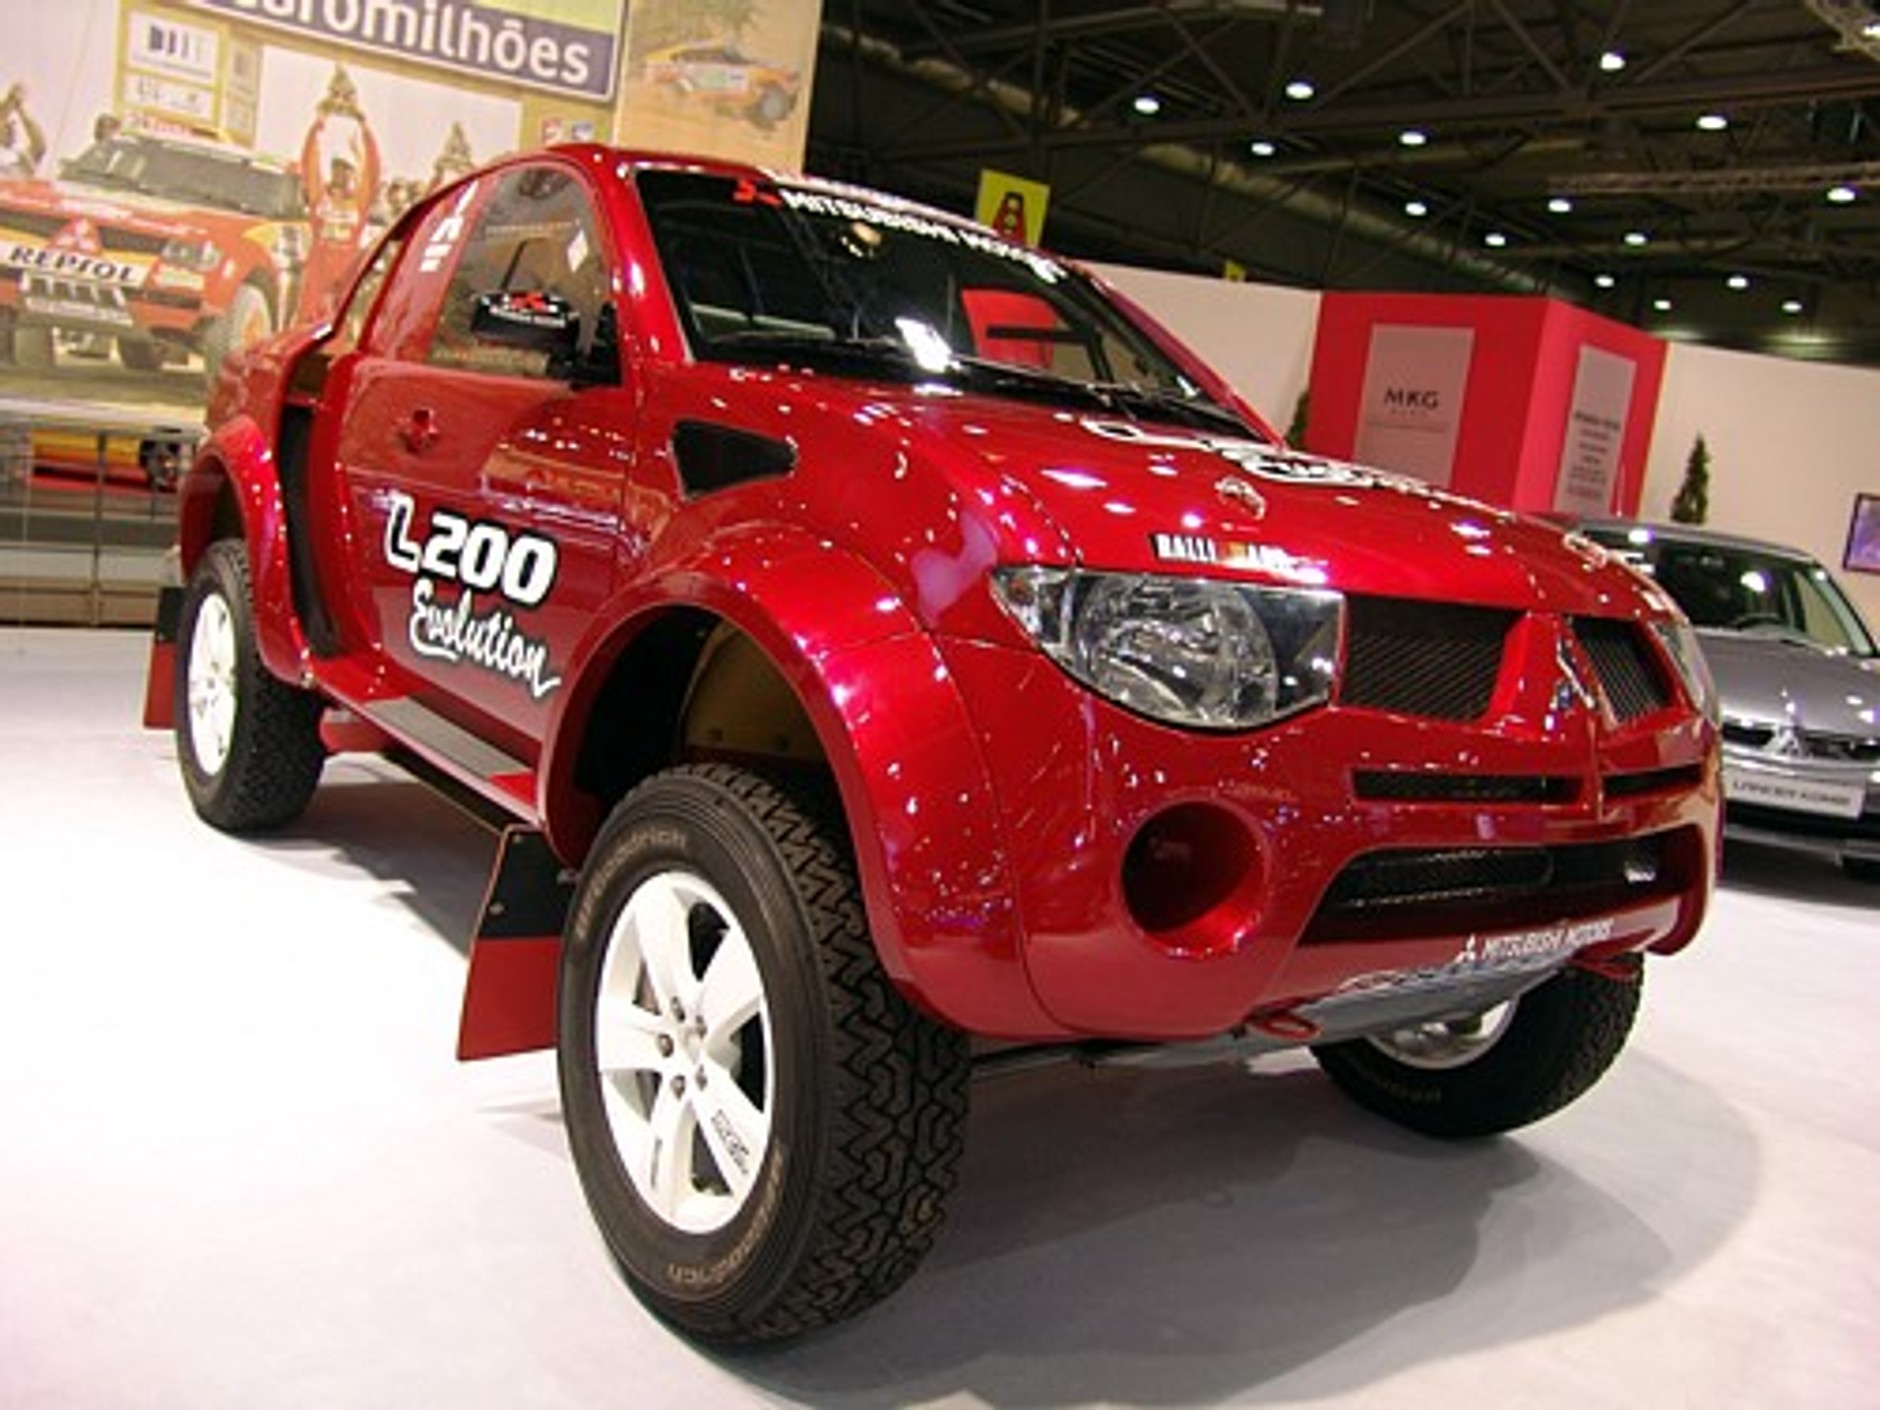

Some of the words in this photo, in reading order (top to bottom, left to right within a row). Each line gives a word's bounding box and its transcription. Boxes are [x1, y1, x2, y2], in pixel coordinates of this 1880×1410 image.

[232, 0, 590, 84] romilhões
[9, 246, 139, 284] REPSOL
[1383, 386, 1439, 411] MKG
[384, 490, 557, 605] L200
[410, 577, 562, 699] Evolution
